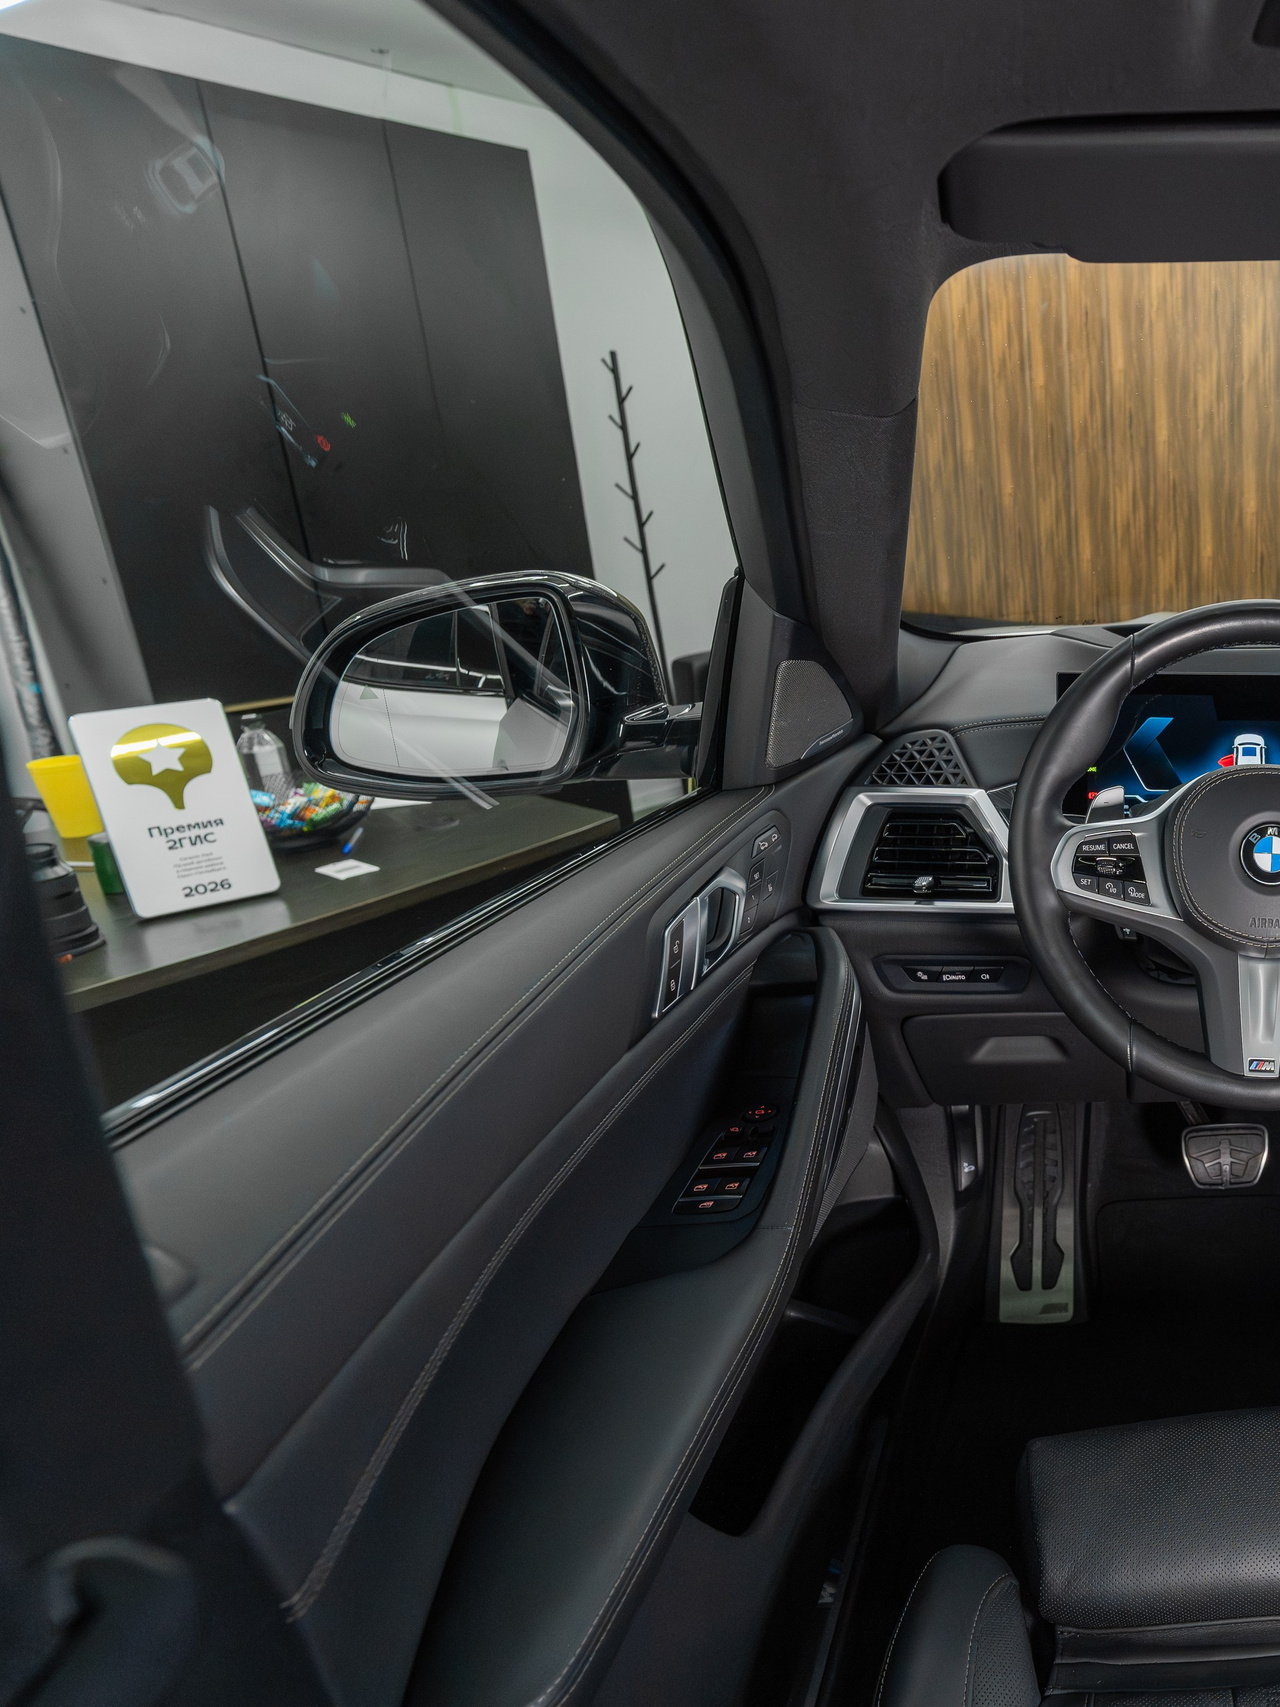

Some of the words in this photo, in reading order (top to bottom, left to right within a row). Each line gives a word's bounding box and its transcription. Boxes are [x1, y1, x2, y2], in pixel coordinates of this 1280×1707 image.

[147, 818, 225, 838] Премия
[165, 832, 217, 851] 2ГИС
[1112, 842, 1134, 850] CANCEL
[182, 879, 232, 898] 2026
[1130, 891, 1145, 899] MODE
